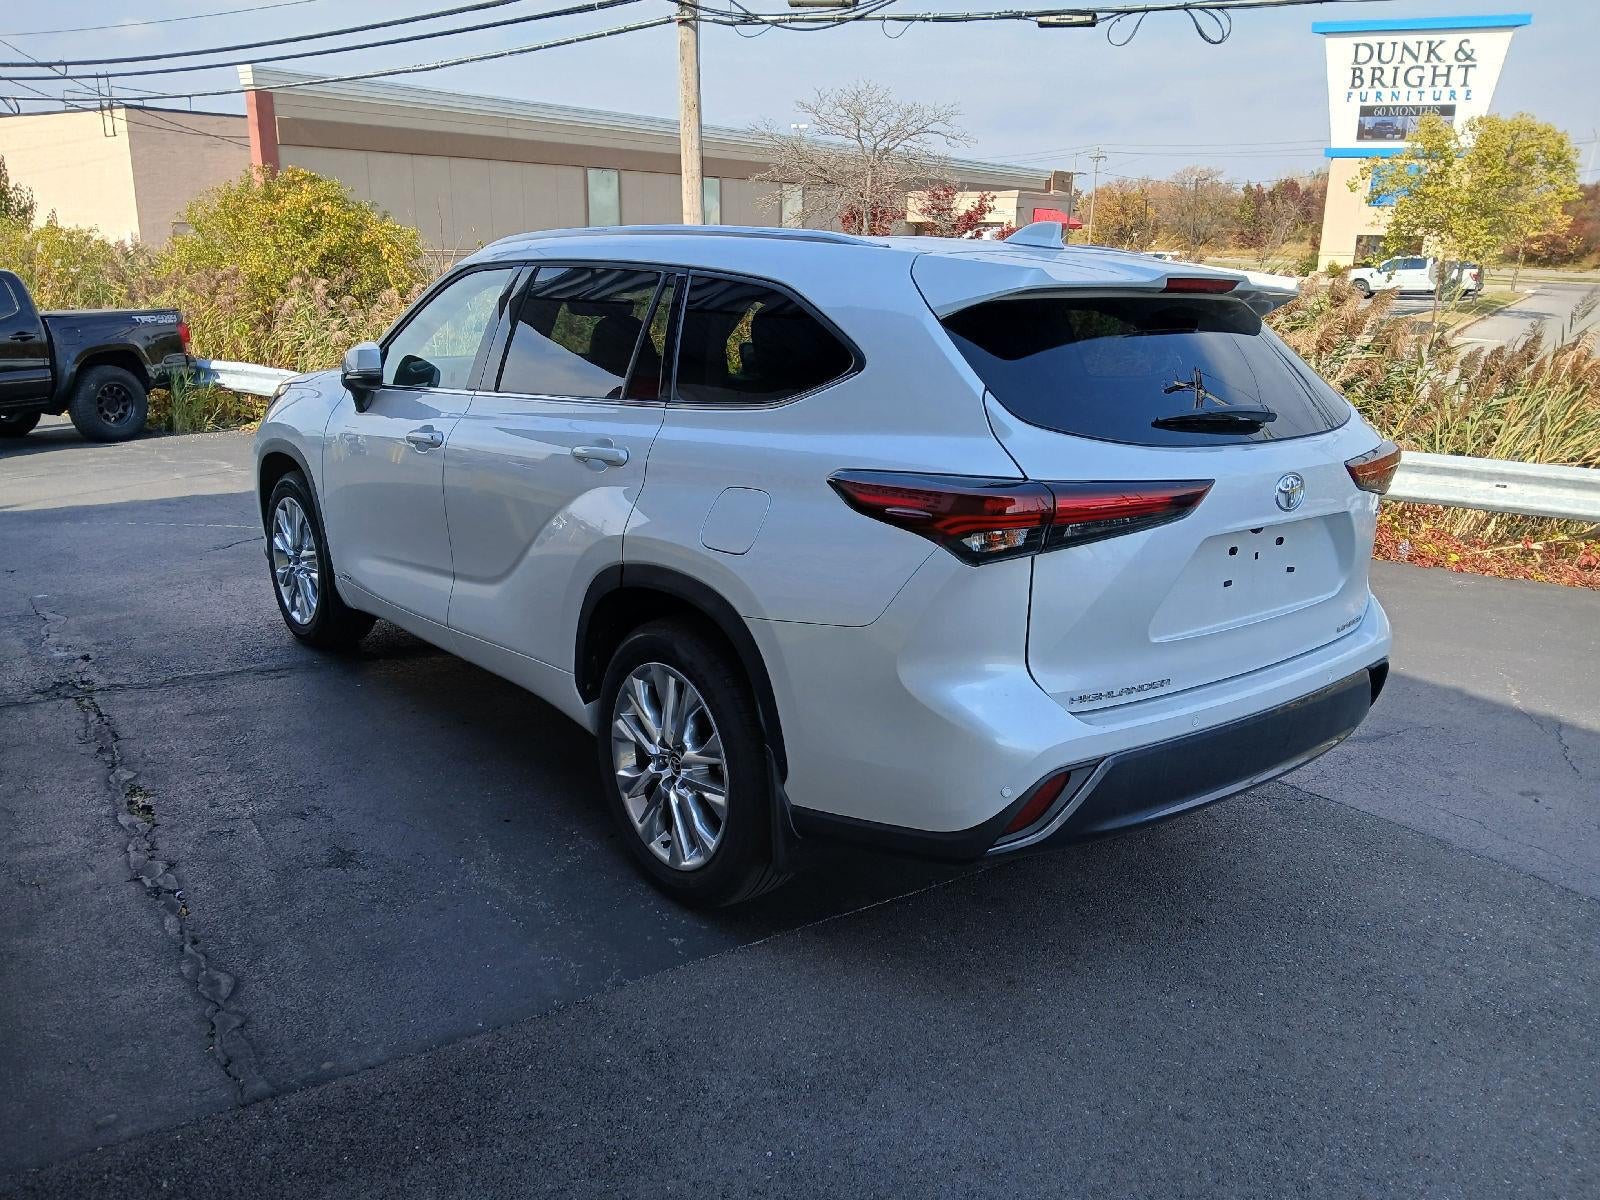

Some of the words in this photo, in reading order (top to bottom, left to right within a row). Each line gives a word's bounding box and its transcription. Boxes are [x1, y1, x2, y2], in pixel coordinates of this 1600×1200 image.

[1352, 40, 1446, 65] DUNK
[1454, 38, 1478, 63] &
[1349, 64, 1477, 89] BRIGHT
[1346, 89, 1472, 103] FURNITURE
[1373, 106, 1386, 117] 60
[1388, 105, 1441, 117] MONTHS
[1068, 678, 1171, 705] HIGHLANDER
